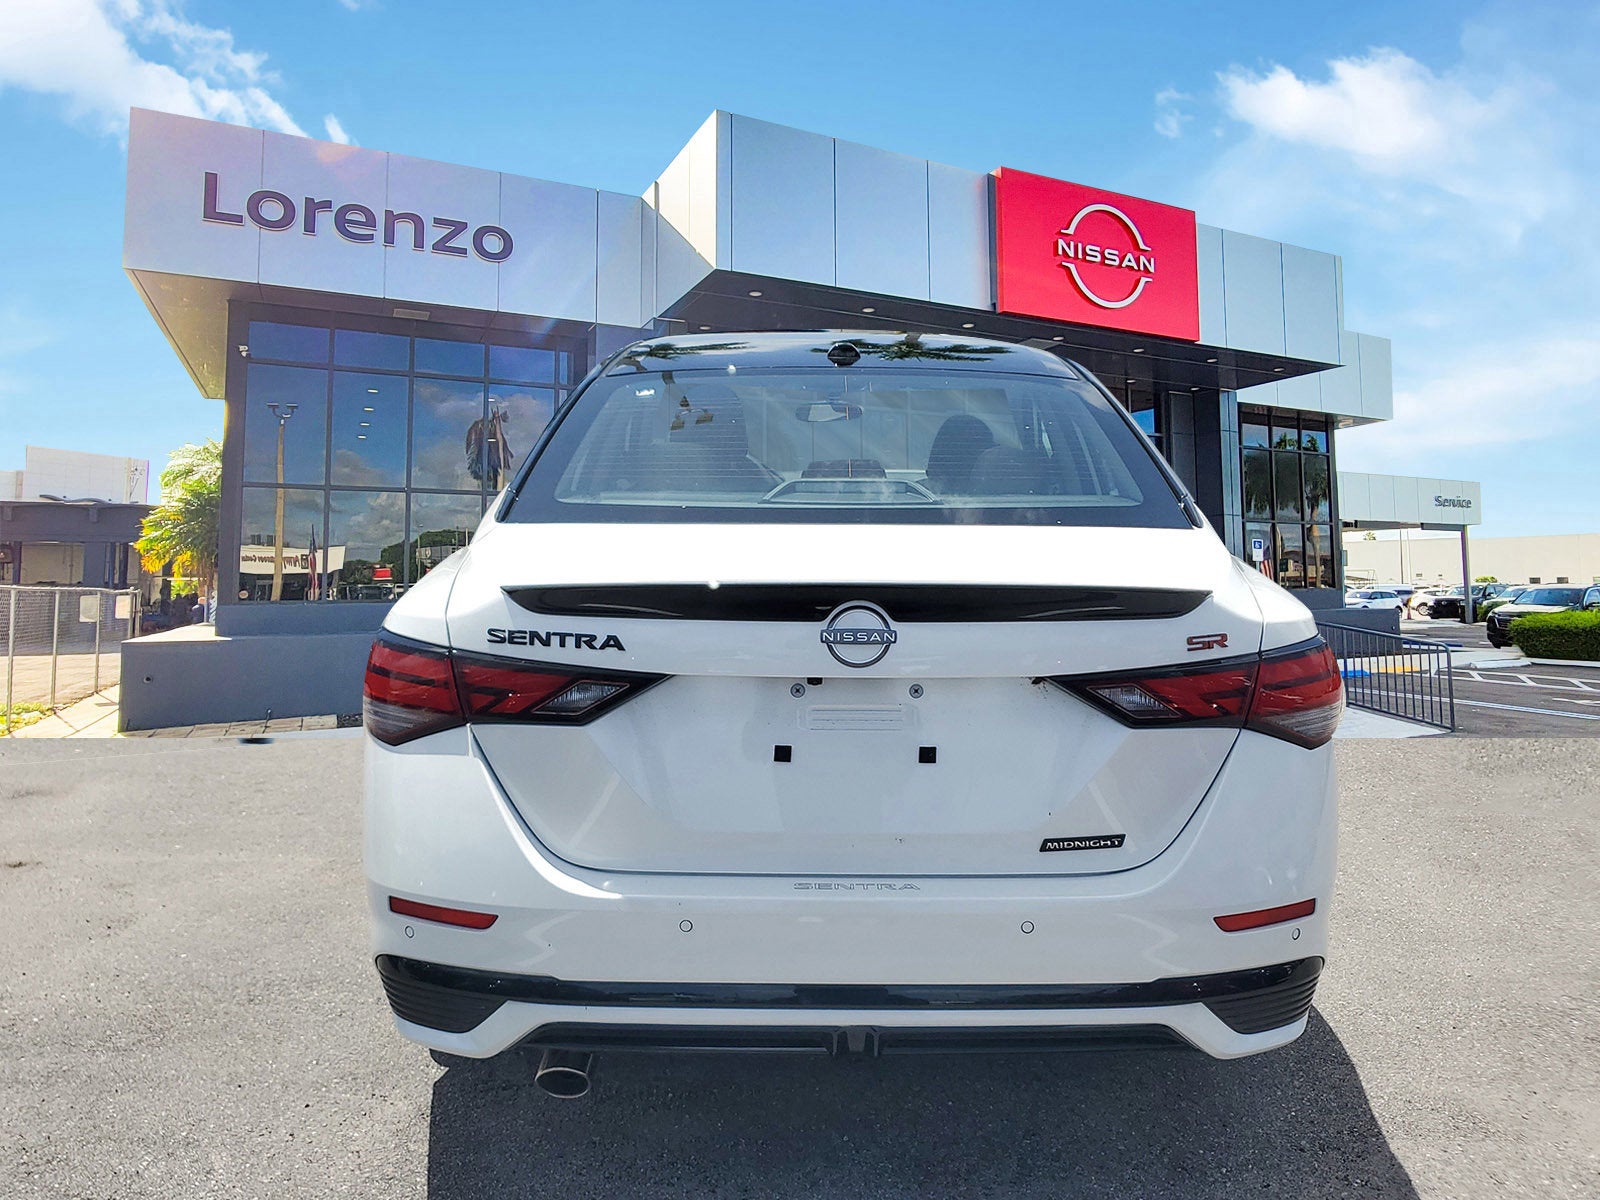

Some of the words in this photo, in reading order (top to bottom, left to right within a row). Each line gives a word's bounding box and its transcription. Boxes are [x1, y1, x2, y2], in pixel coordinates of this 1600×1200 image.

[202, 170, 515, 263] Lorenzo
[1057, 238, 1155, 273] NISSAN
[1434, 495, 1472, 509] Service
[487, 627, 626, 652] SENTRA
[822, 631, 896, 643] NISSAN
[1186, 633, 1229, 651] SR
[1045, 838, 1122, 850] MIDNIGHT
[793, 881, 921, 891] SENTRA
